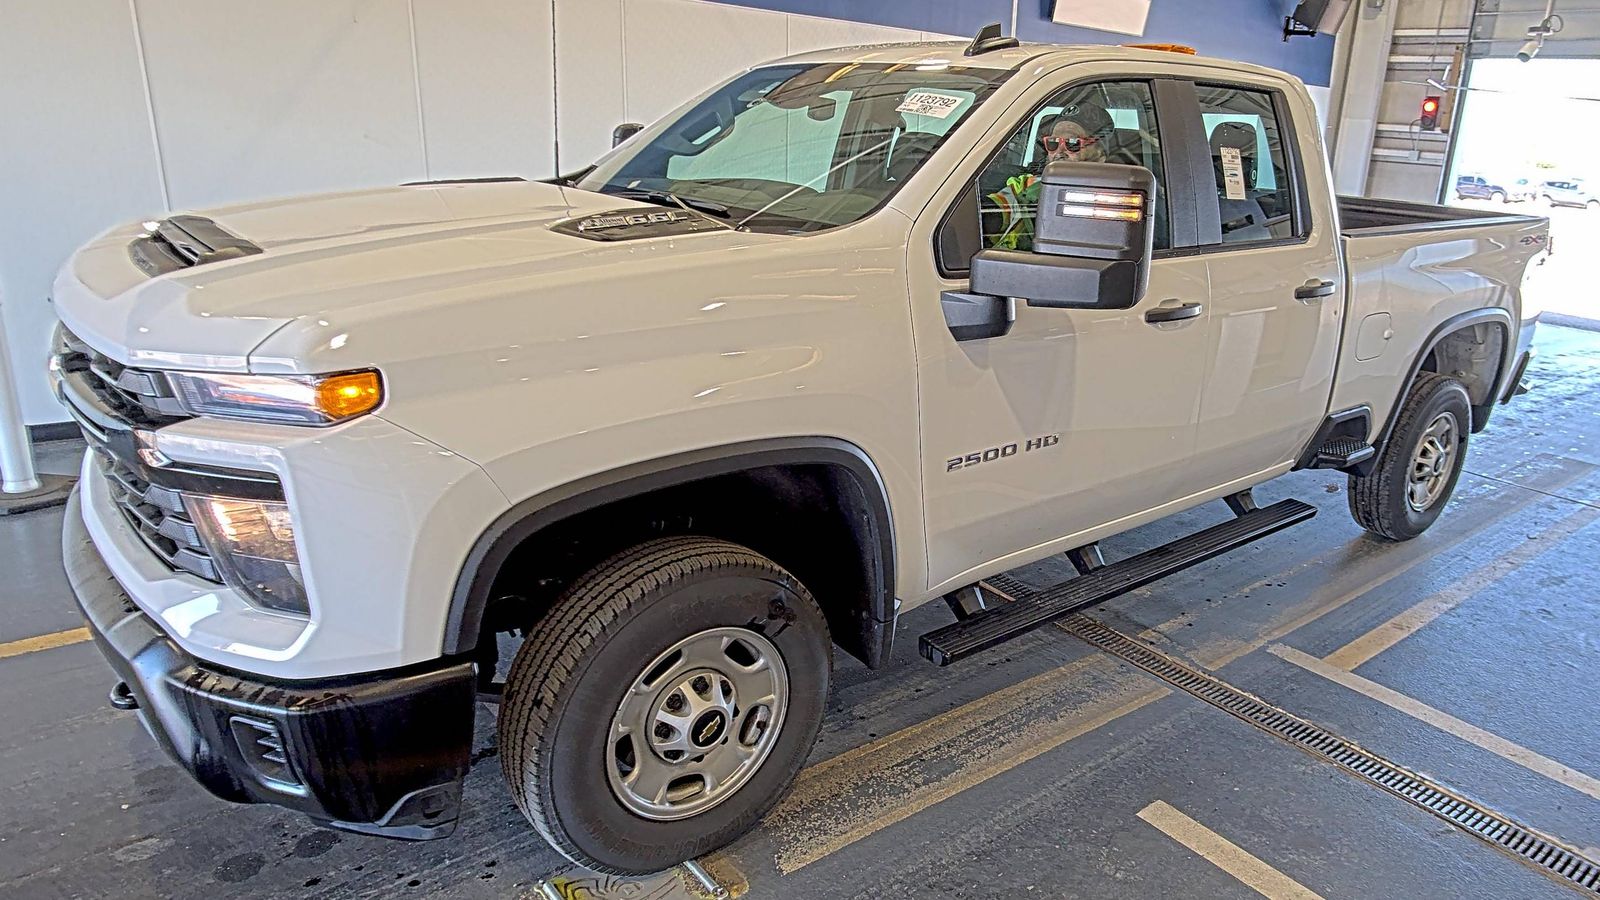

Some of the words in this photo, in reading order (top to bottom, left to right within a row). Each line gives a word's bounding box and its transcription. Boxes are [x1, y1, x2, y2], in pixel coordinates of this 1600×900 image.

[910, 93, 957, 108] 1123792
[946, 443, 1018, 472] 2500
[1025, 434, 1060, 452] HD
